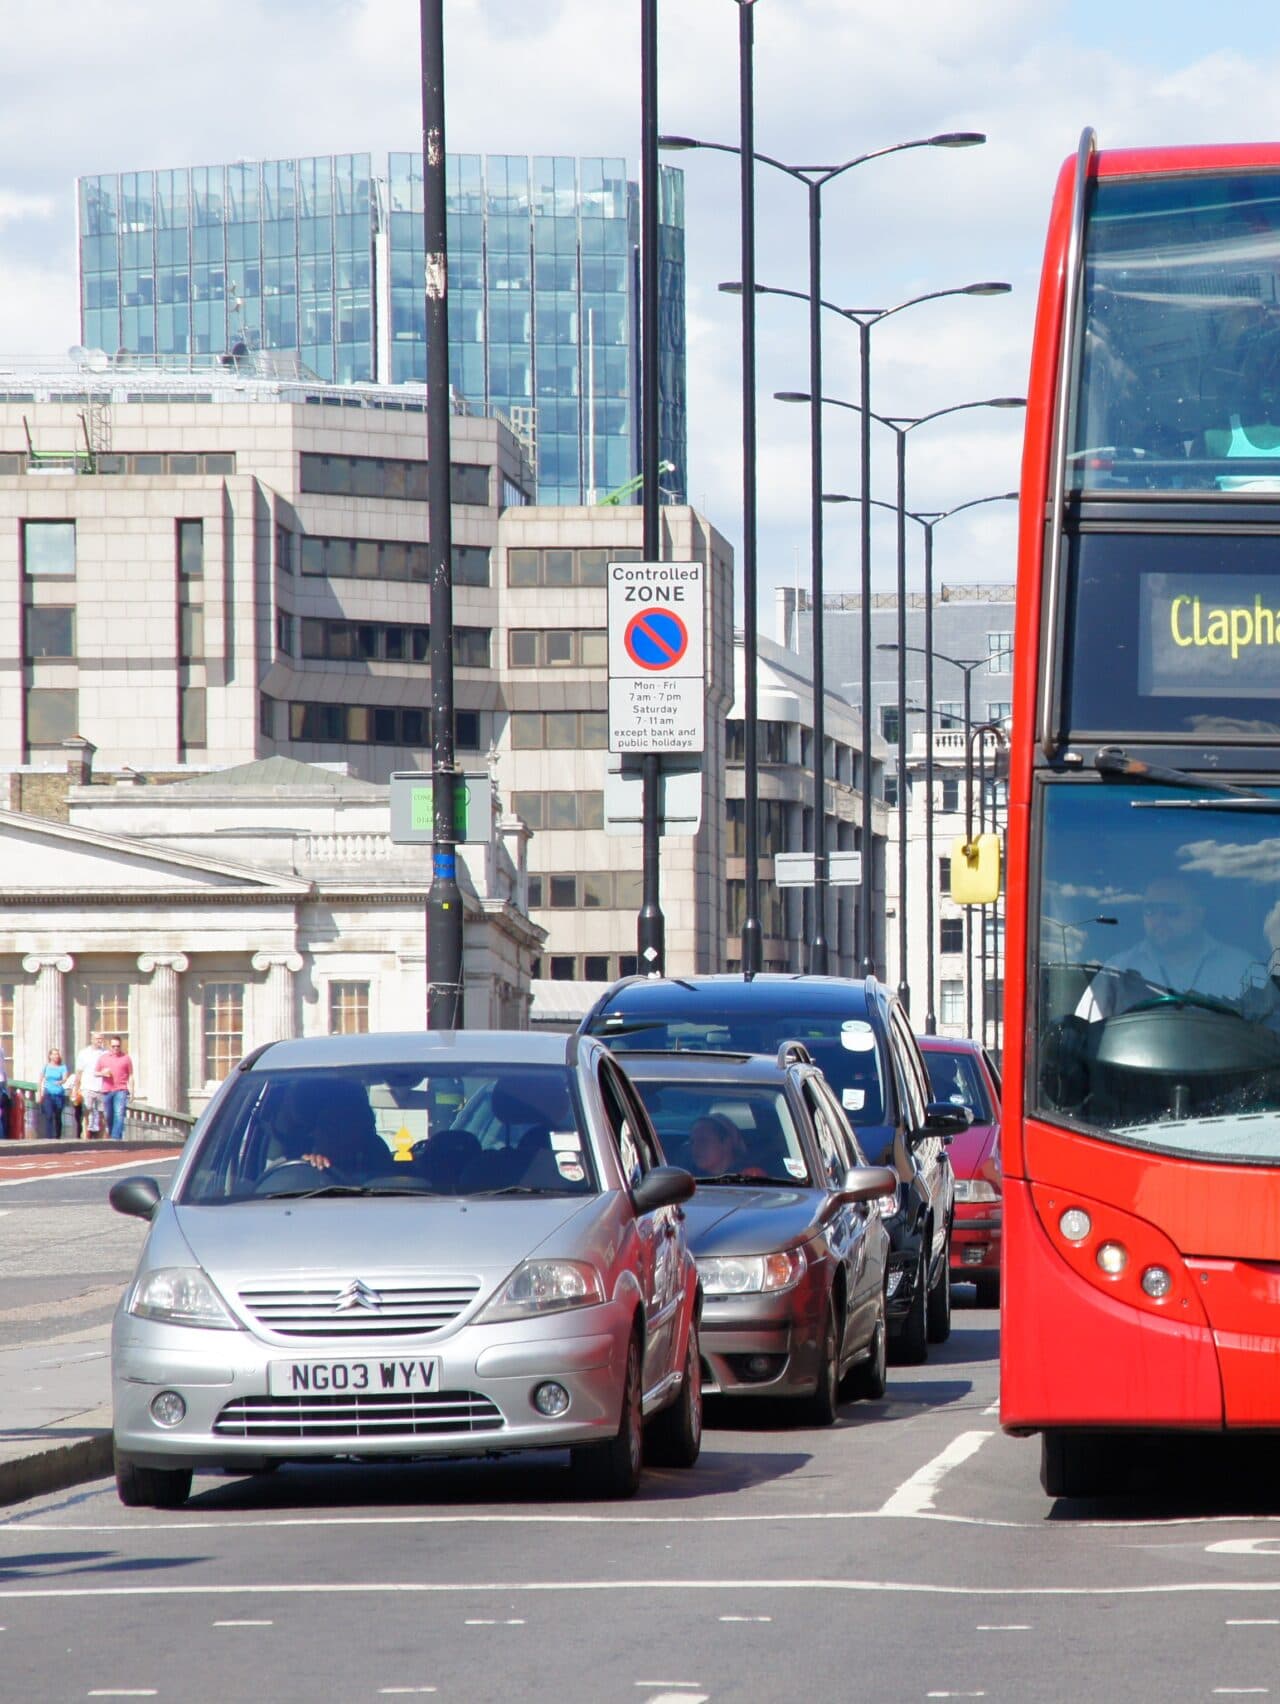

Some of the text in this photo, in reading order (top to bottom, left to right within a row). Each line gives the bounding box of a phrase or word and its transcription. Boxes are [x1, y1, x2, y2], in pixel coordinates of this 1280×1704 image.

[613, 567, 699, 580] Controlled
[625, 586, 685, 602] ZONE
[634, 682, 655, 690] Mon
[663, 682, 677, 690] Fri
[633, 705, 678, 714] Saturday
[614, 728, 696, 737] except bank and
[618, 738, 693, 747] public holidays
[292, 1361, 434, 1390] NG03 WYV
